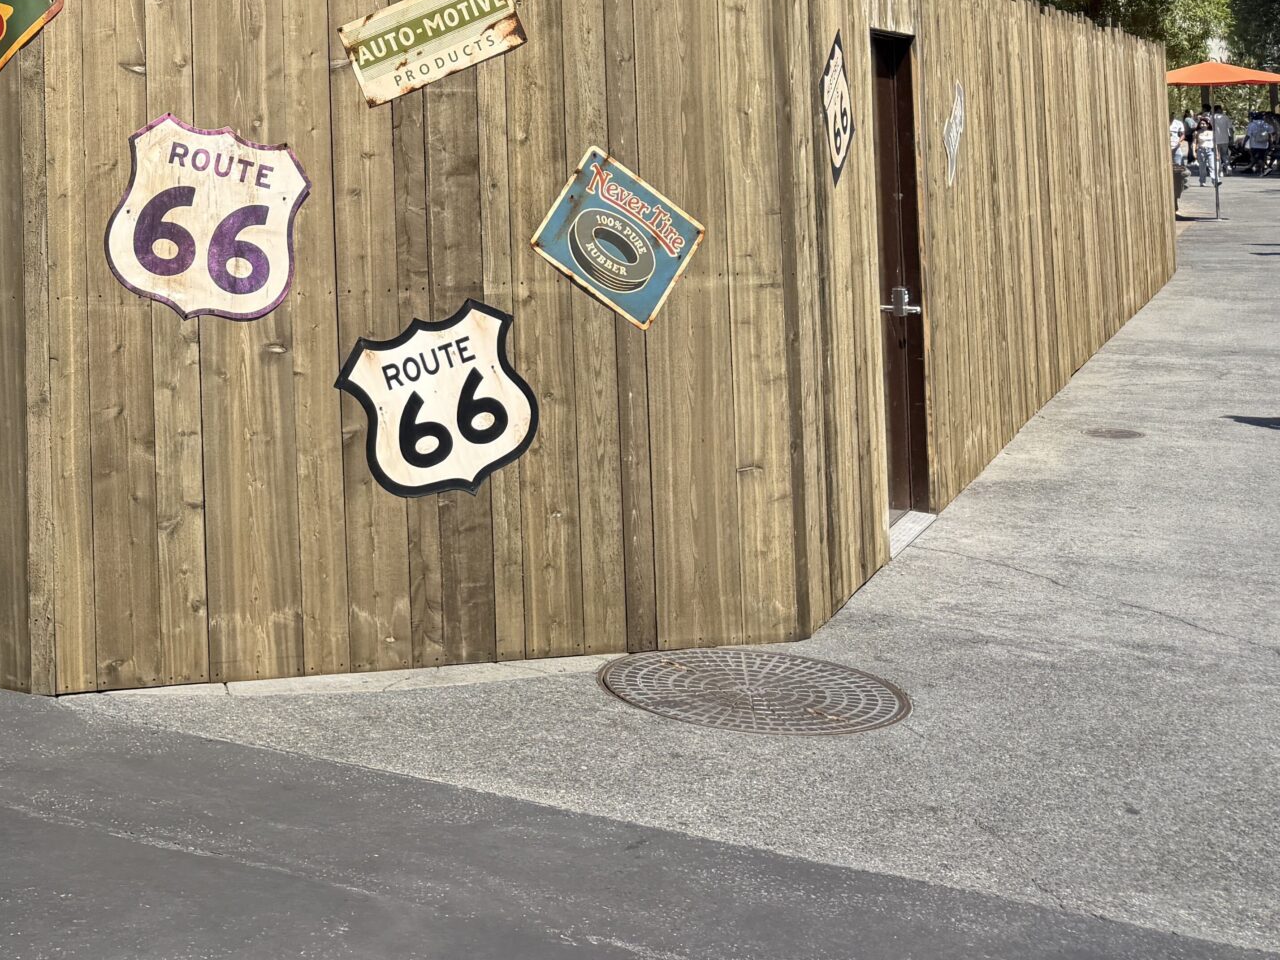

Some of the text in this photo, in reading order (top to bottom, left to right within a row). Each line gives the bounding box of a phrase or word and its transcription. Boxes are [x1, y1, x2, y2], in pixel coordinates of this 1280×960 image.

[393, 34, 496, 87] PRODUCTS
[833, 90, 848, 156] 66
[168, 141, 275, 190] ROUTE
[586, 162, 686, 255] Never Tire
[595, 214, 647, 255] 100% PURE
[133, 185, 271, 296] 66
[585, 242, 628, 276] RUBBER
[381, 335, 477, 391] ROUTE
[398, 366, 509, 469] 66
